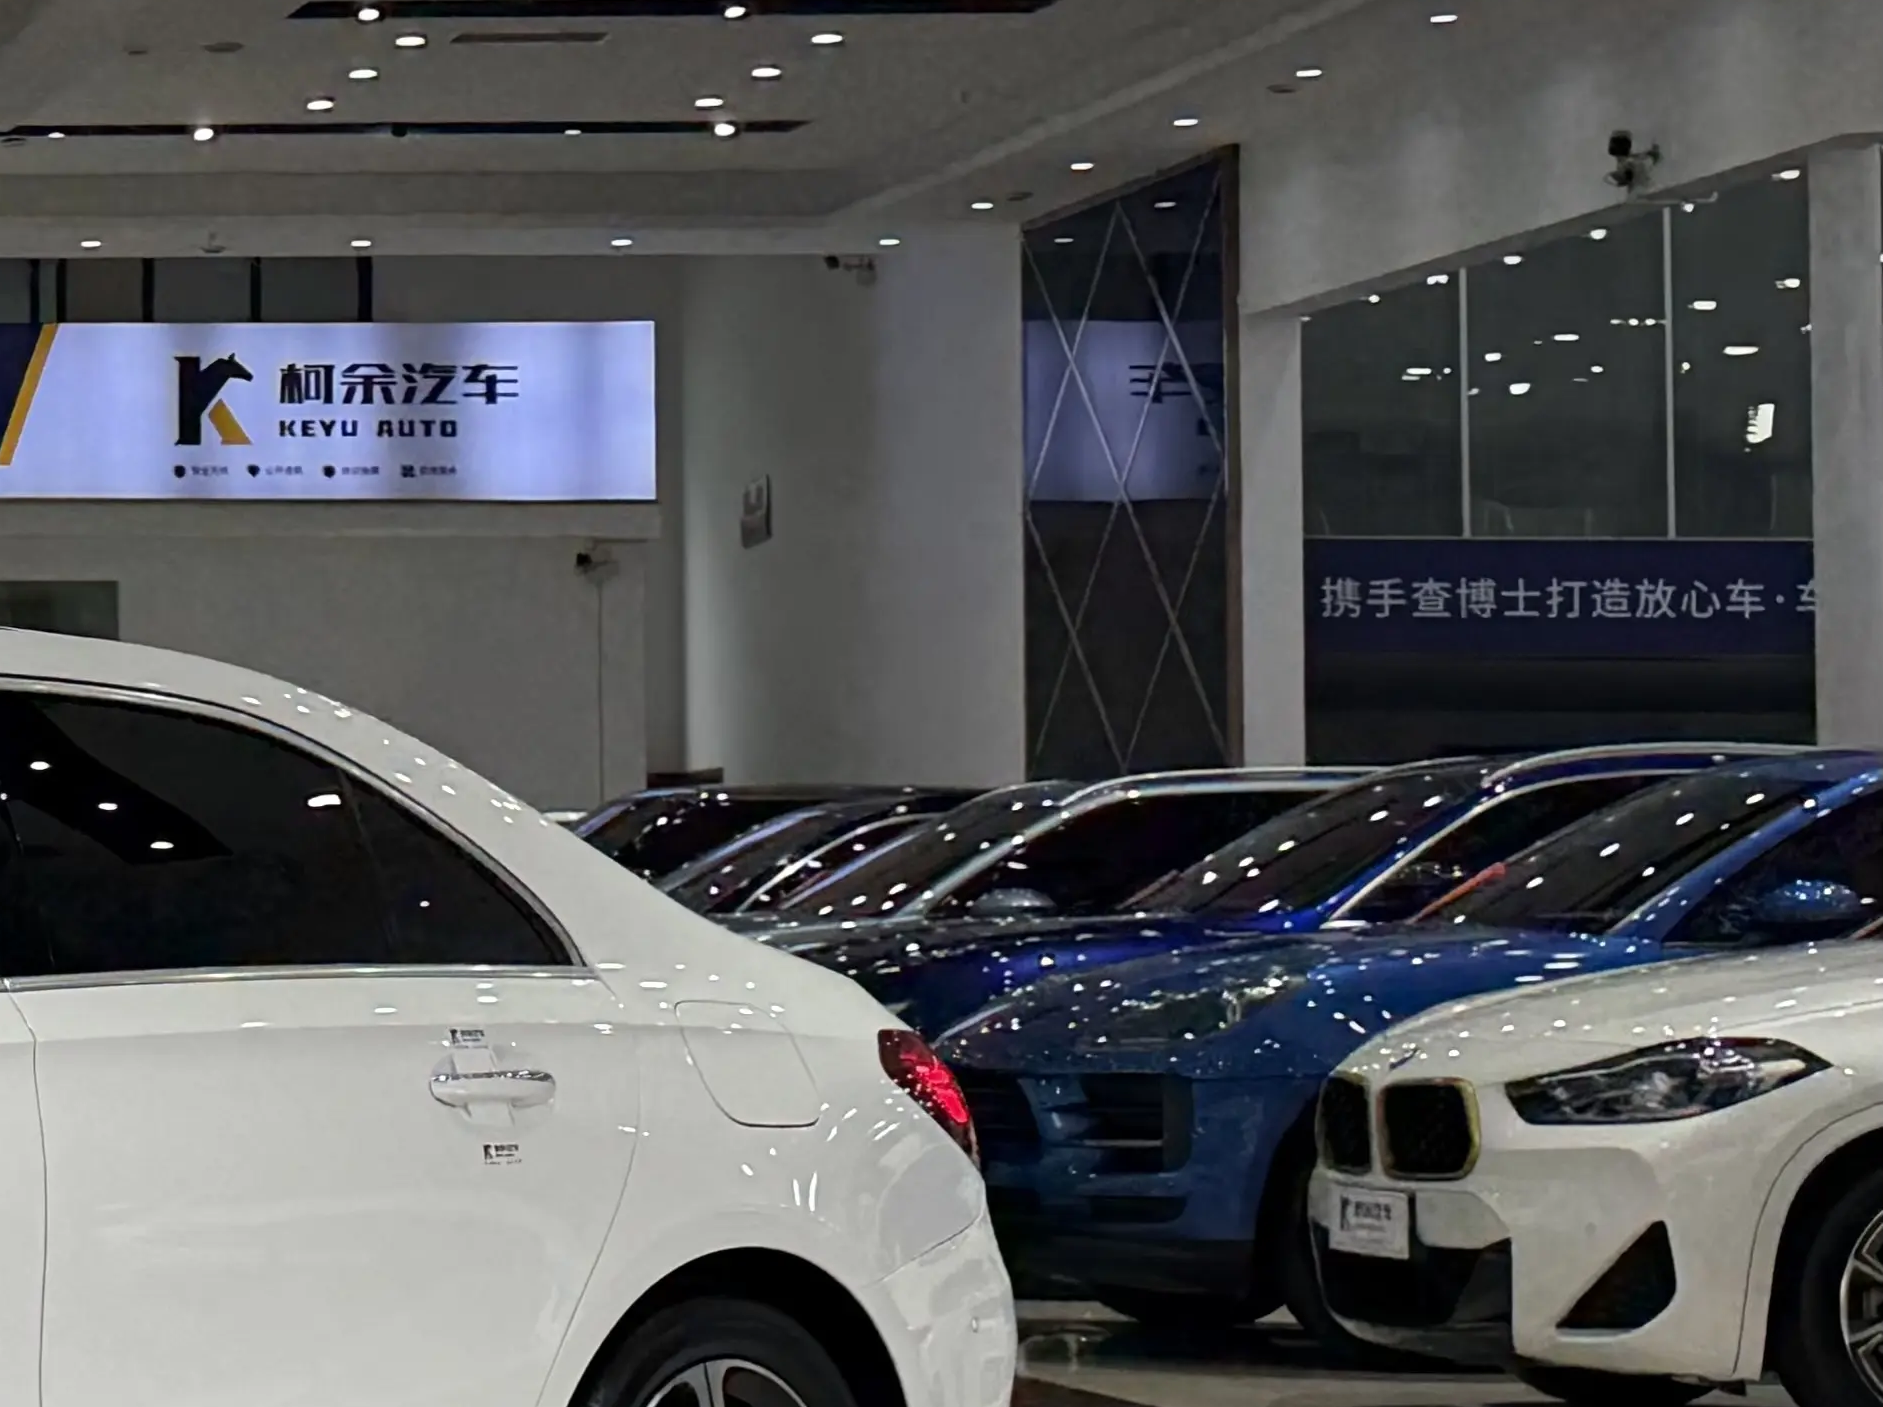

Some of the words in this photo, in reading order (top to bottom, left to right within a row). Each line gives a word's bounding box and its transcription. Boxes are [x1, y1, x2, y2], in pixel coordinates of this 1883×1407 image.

[278, 362, 520, 406] 柯余汽车
[278, 419, 359, 439] KEYU
[376, 419, 458, 439] AUTO
